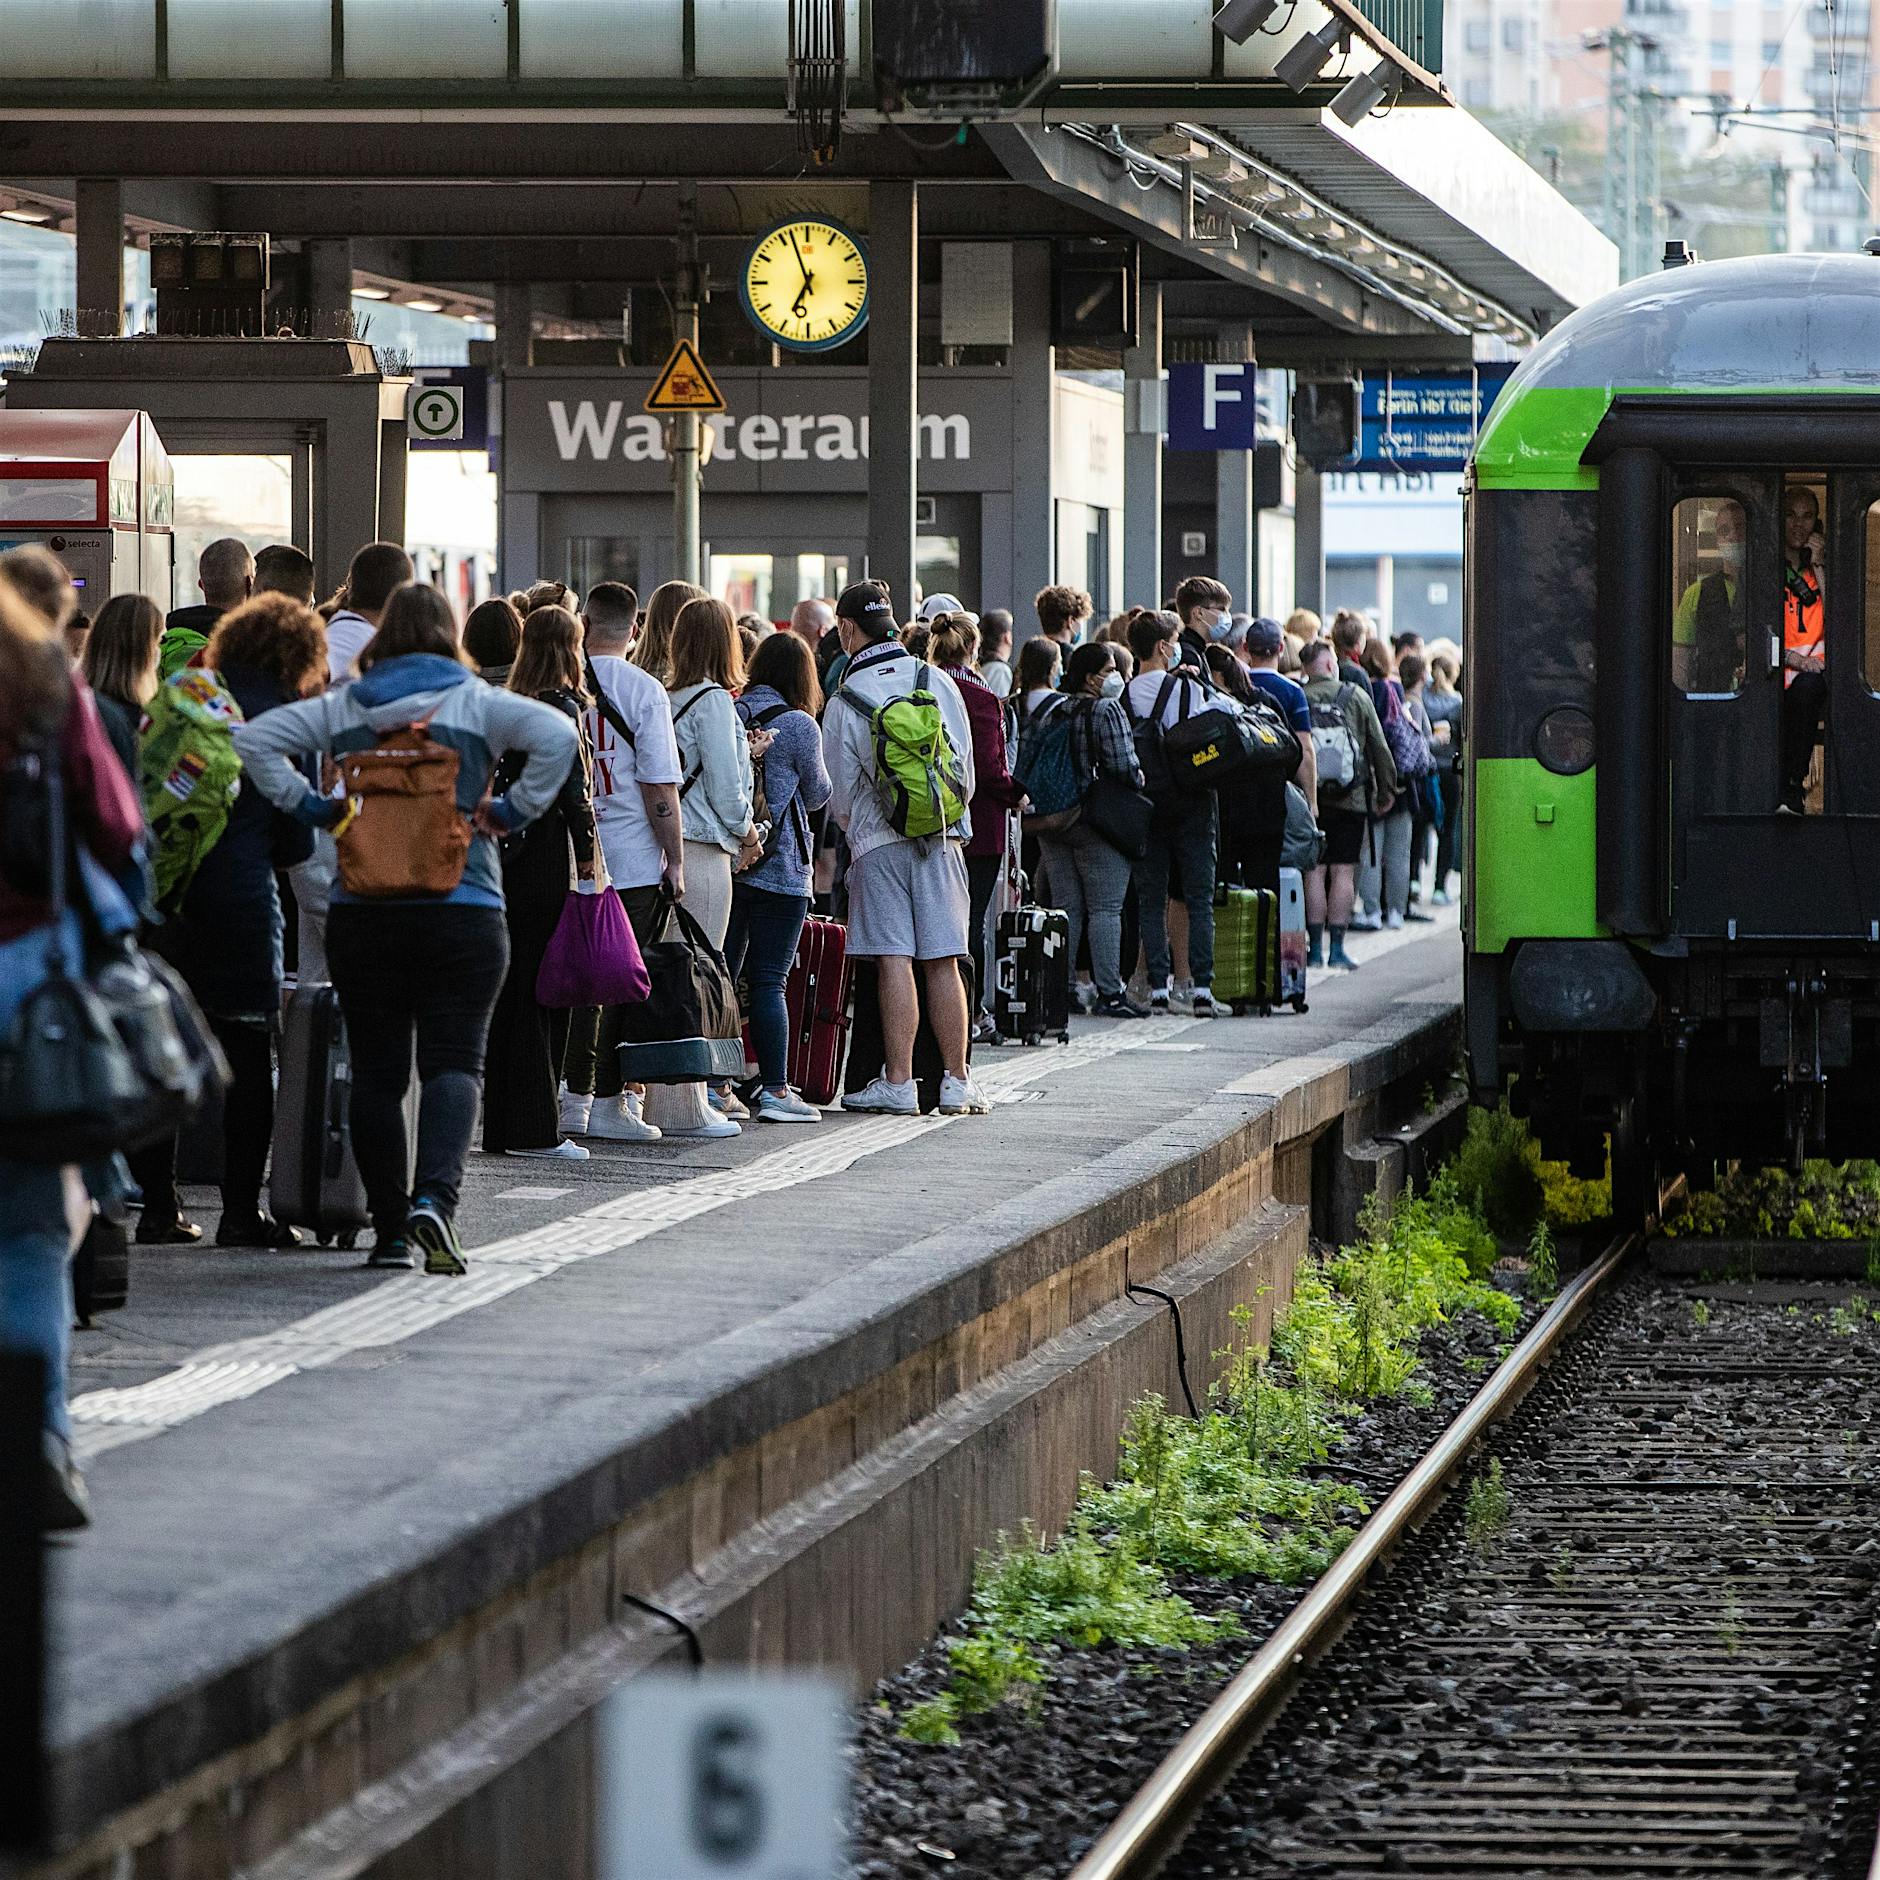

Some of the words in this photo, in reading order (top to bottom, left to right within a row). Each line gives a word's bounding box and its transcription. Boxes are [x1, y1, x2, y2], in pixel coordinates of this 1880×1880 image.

[1203, 363, 1245, 430] F
[547, 400, 971, 461] Wateram
[67, 539, 100, 548] selecta
[688, 1714, 766, 1866] 6
